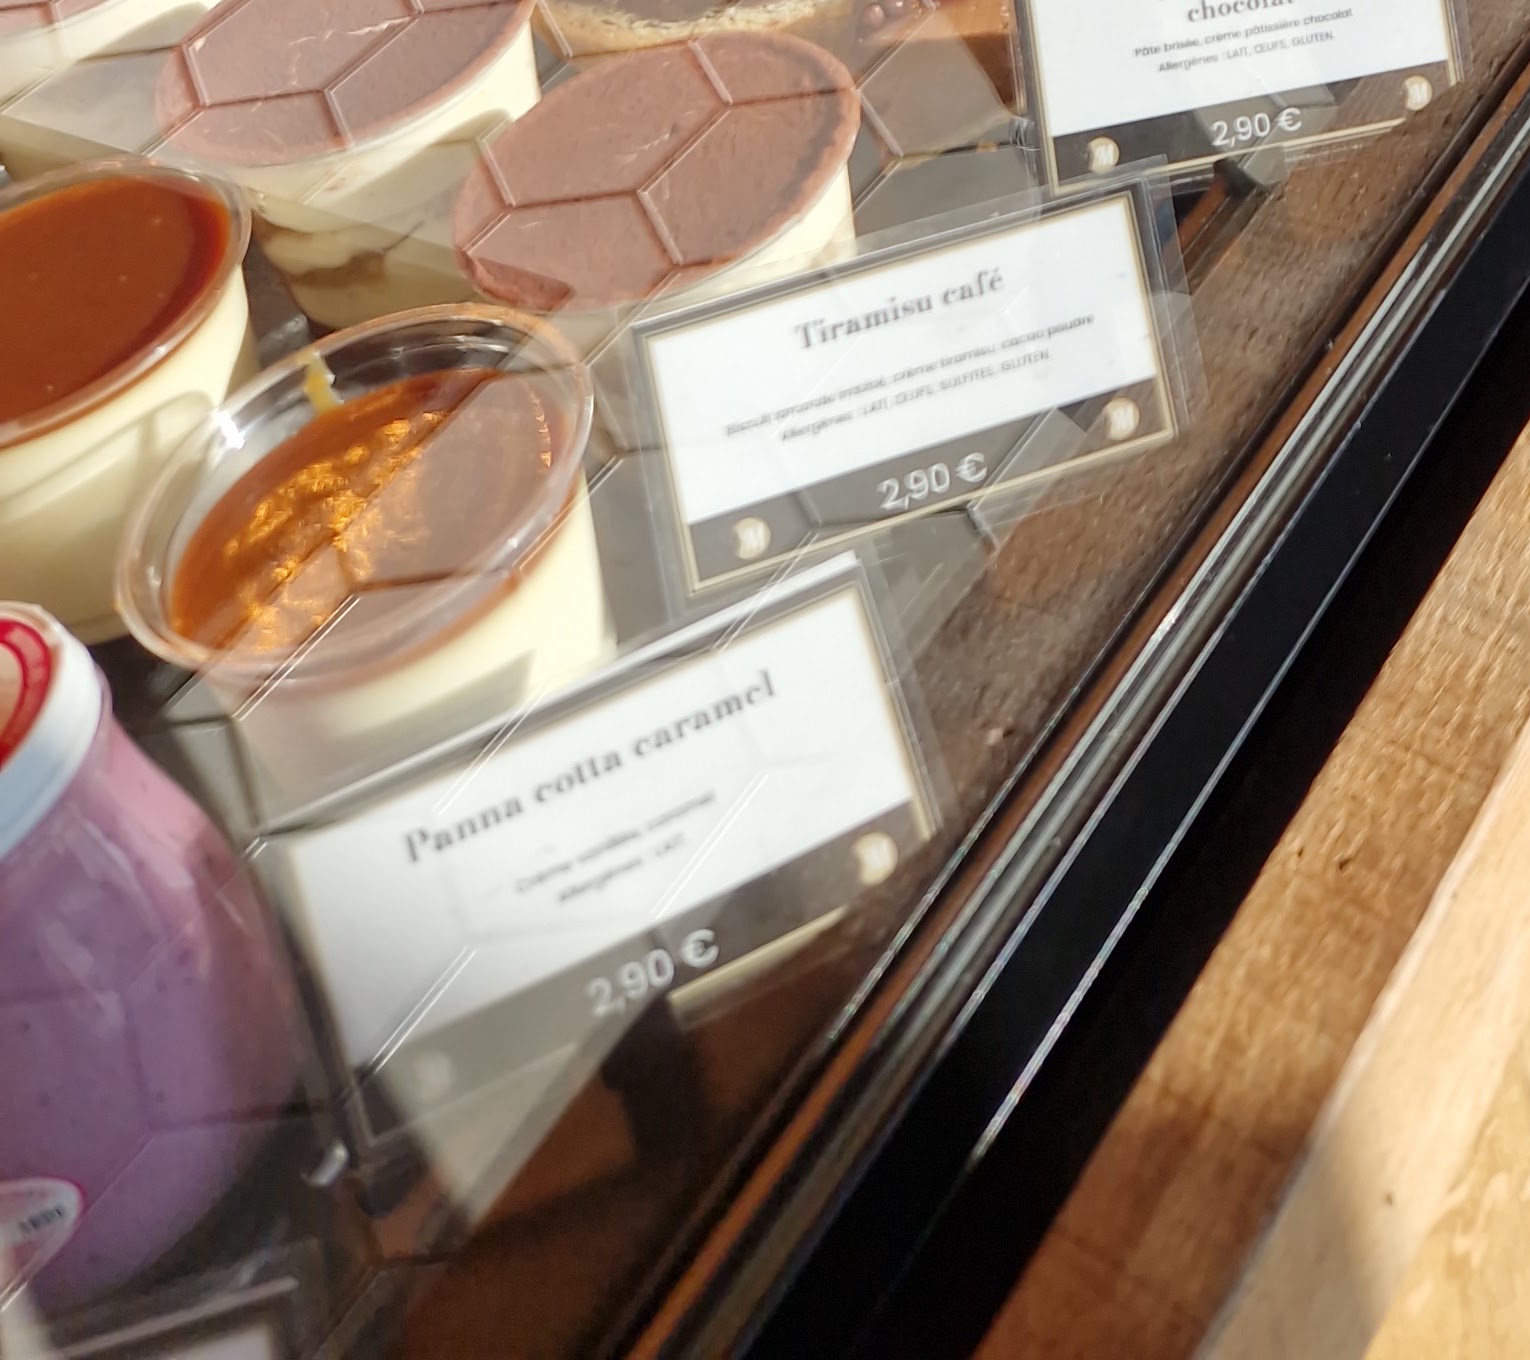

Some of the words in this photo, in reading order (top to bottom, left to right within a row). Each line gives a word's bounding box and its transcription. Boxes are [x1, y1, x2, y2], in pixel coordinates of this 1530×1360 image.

[1134, 44, 1162, 58] Pâte
[1163, 36, 1201, 53] brisée,
[1203, 30, 1242, 46] crème
[1244, 18, 1301, 40] pâtissière
[1302, 7, 1354, 28] chocolat
[1158, 53, 1219, 74] Allergènes
[1227, 46, 1252, 61] LAIT,
[1210, 111, 1272, 149] 2,90
[1276, 106, 1303, 133] €
[793, 289, 934, 353] Tiramisu
[940, 267, 1005, 307] café
[876, 461, 951, 514] 2,90
[954, 450, 991, 486] €
[400, 796, 527, 867] Panna
[532, 747, 625, 809] cotta
[632, 668, 779, 760] caramel
[585, 947, 677, 1021] 2,90
[681, 927, 722, 971] €
